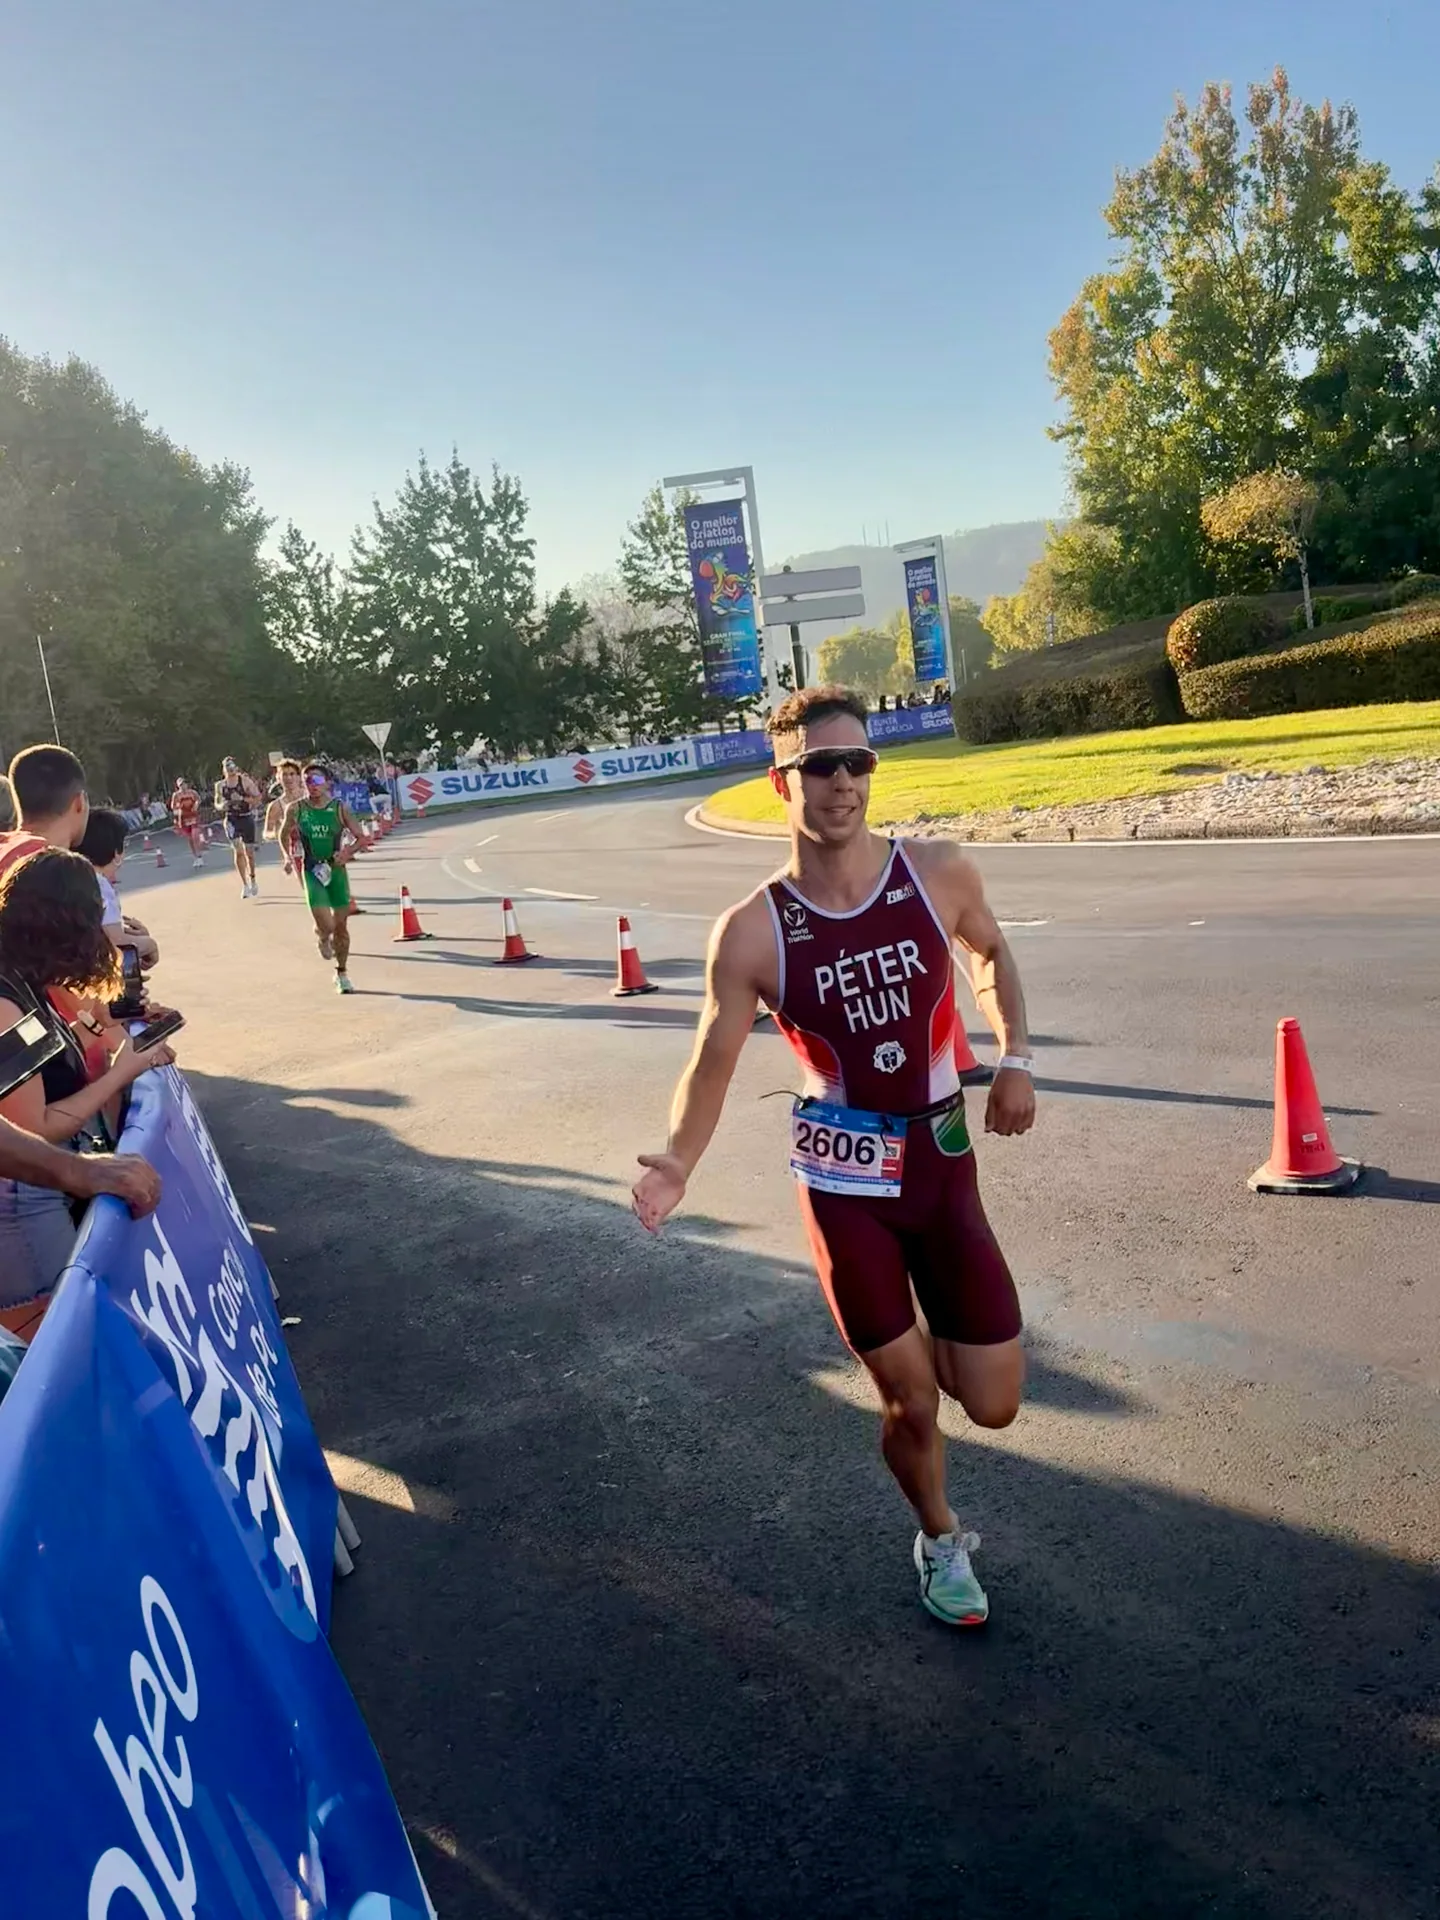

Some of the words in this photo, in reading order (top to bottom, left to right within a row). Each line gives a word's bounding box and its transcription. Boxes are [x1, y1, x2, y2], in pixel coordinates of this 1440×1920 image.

[691, 520, 700, 530] O
[703, 515, 738, 528] mellor
[690, 536, 704, 549] do
[706, 531, 743, 548] mundo
[601, 750, 689, 777] SUZUKI
[441, 768, 549, 796] SUZUKI
[814, 939, 928, 1005] PÉTER
[843, 985, 911, 1033] HUN
[795, 1122, 876, 1165] 2606
